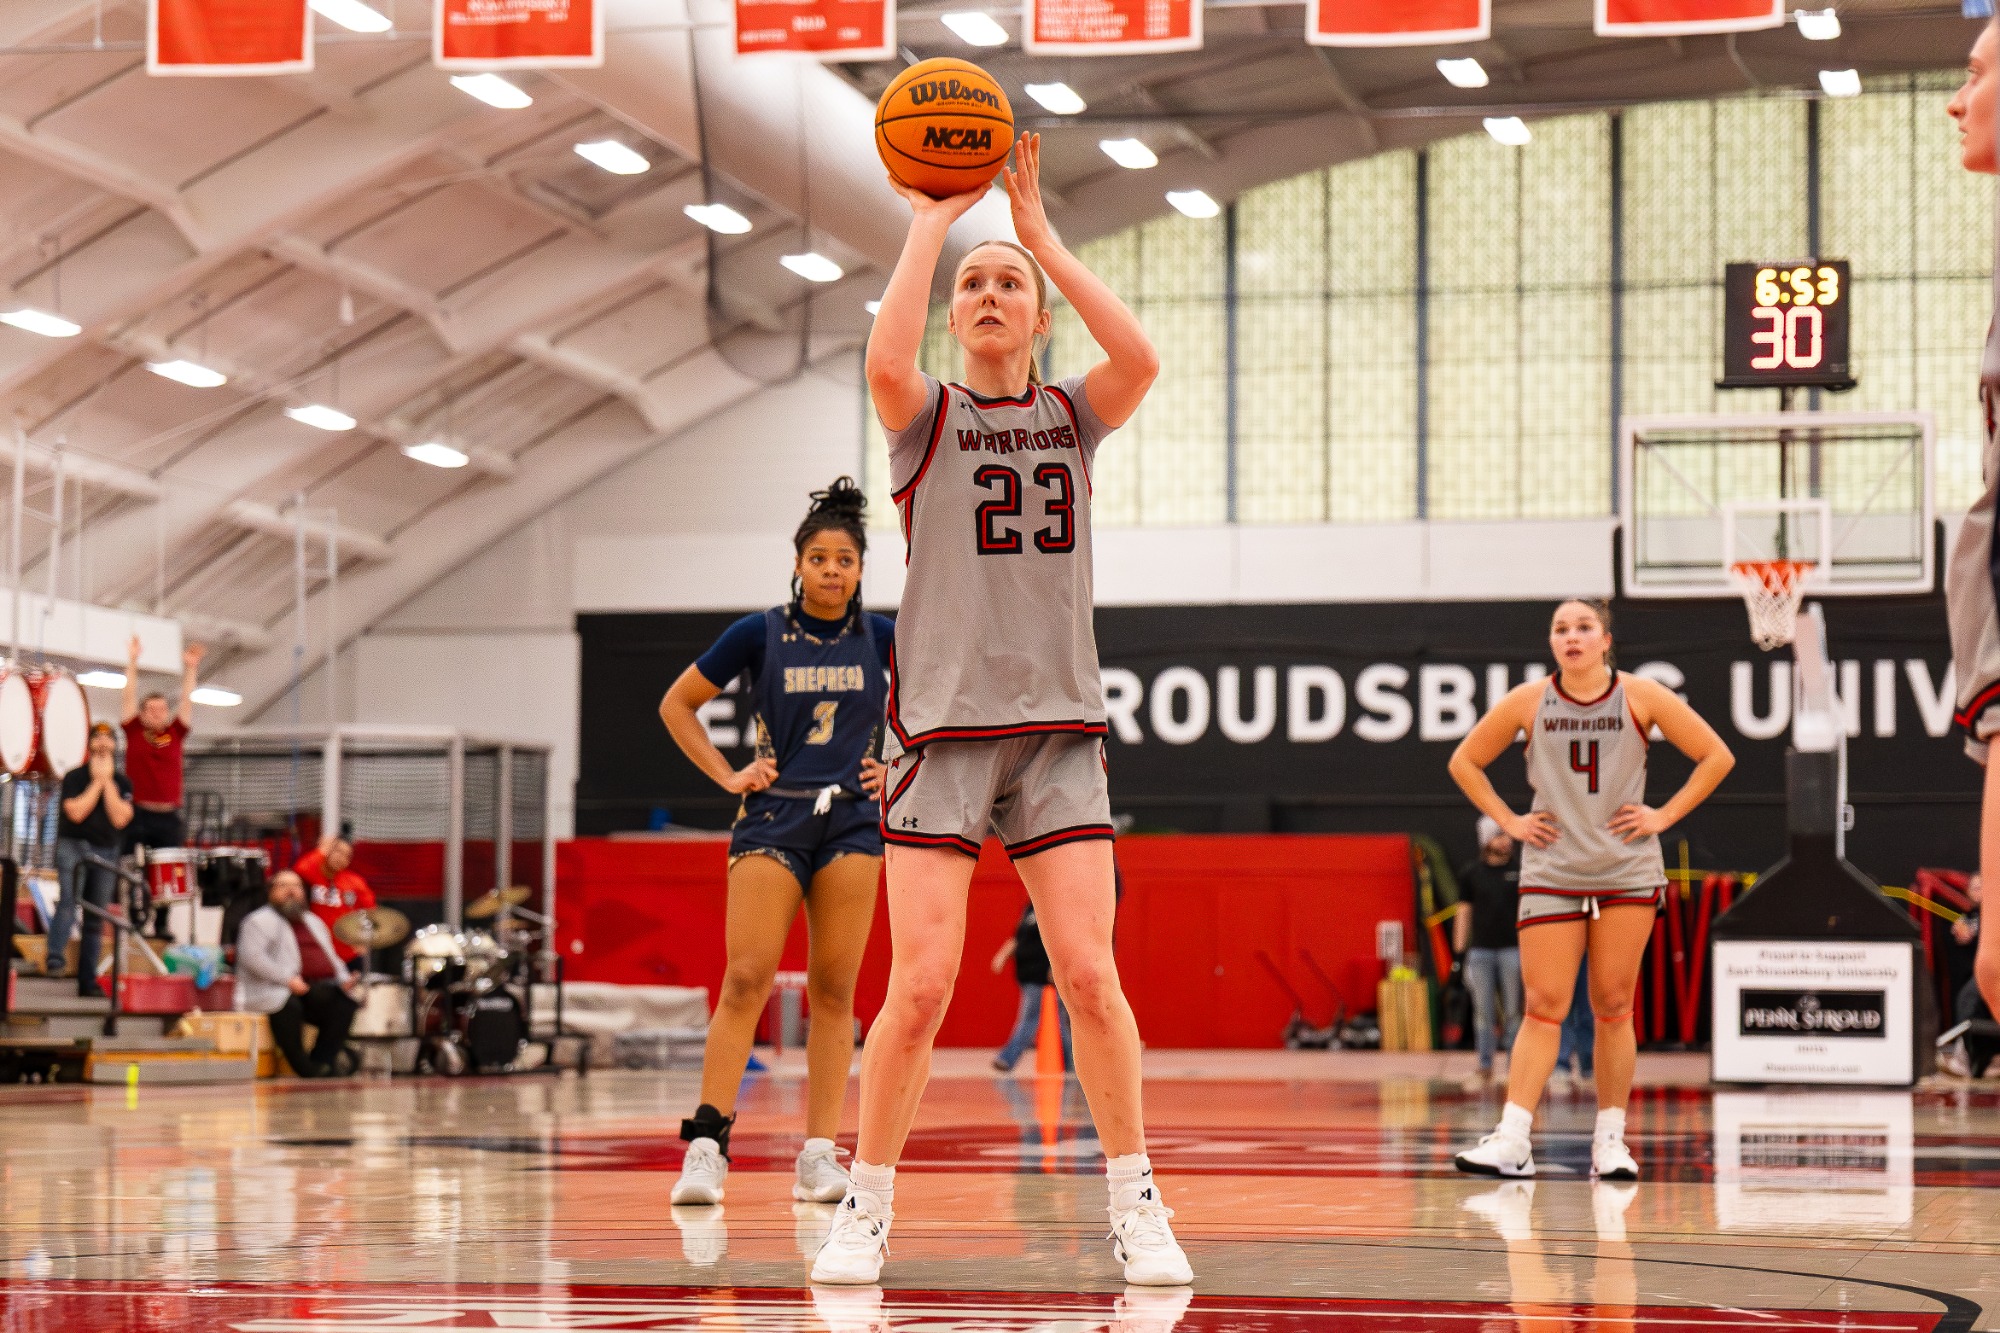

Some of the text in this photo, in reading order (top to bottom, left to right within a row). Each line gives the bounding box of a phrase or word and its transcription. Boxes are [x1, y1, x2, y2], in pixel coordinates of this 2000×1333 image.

[909, 79, 1000, 111] Wilson
[922, 126, 992, 150] NCAA
[1755, 267, 1839, 307] 6:53
[1751, 305, 1822, 369] 30
[957, 425, 1076, 454] WARRIORS
[974, 463, 1075, 555] 23
[784, 665, 864, 694] SHEPHERD
[805, 700, 839, 745] 3
[1570, 739, 1599, 794] 4
